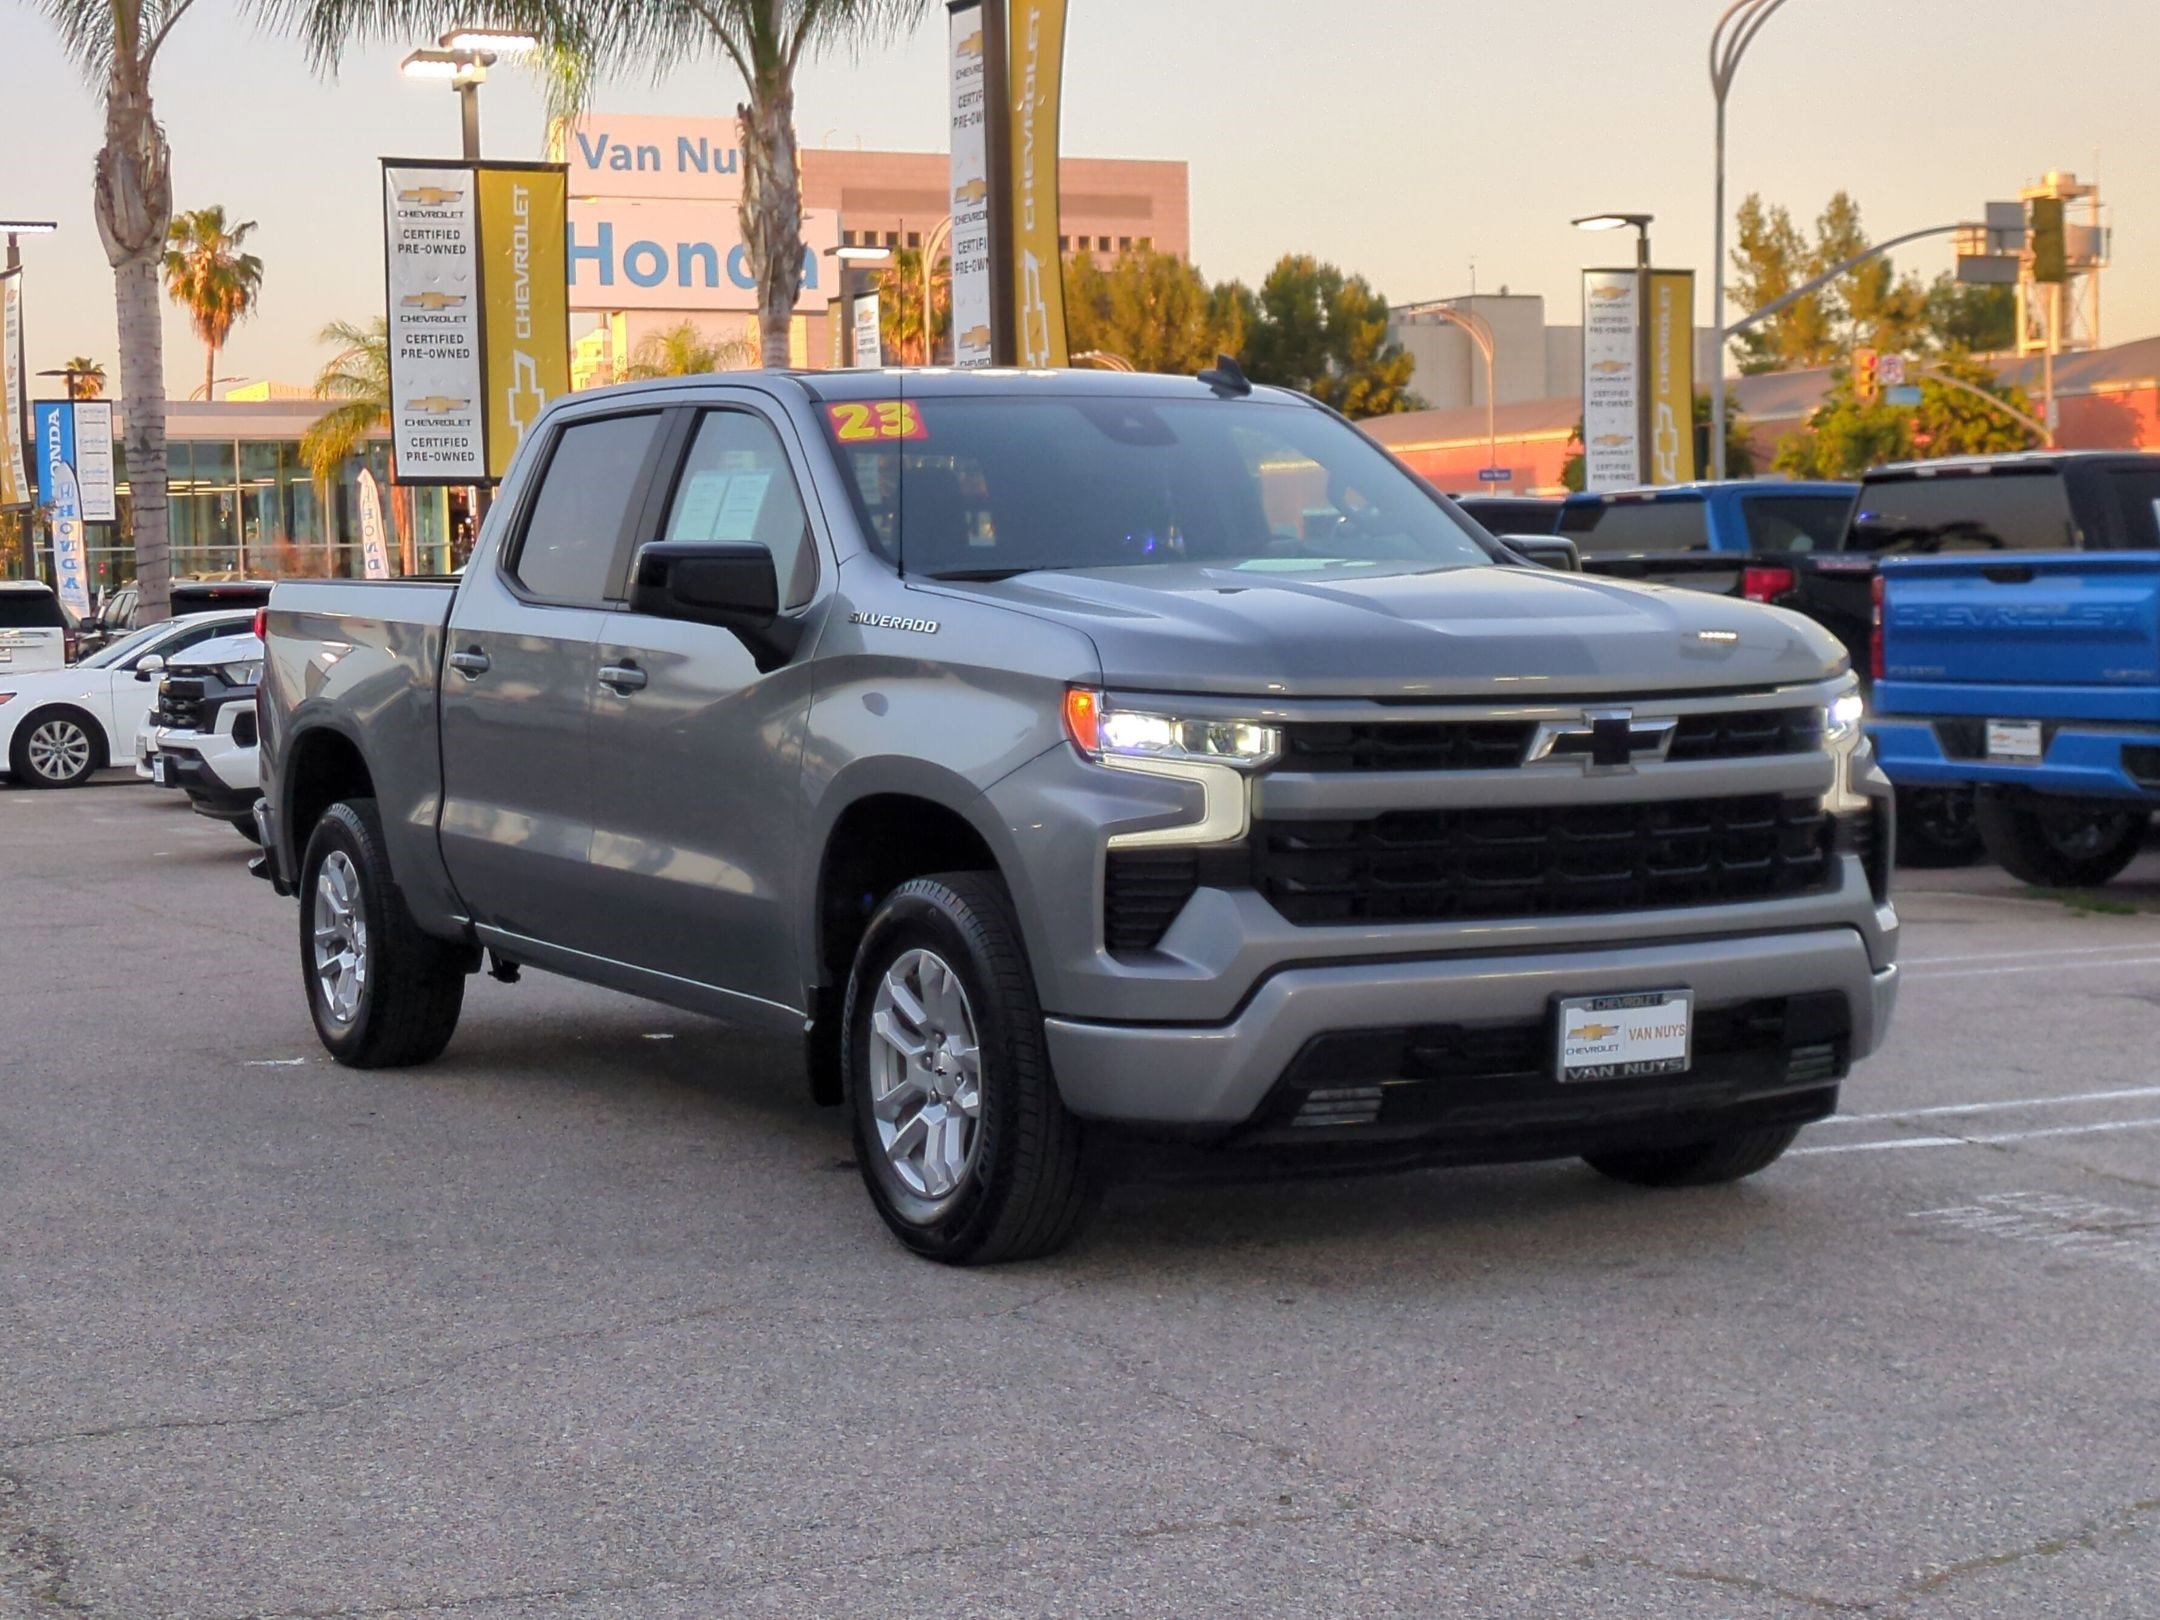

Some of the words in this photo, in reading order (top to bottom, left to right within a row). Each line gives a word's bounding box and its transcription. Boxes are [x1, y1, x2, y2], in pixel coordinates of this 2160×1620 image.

[955, 63, 984, 80] CHEVRO
[958, 89, 984, 108] CERTIF
[953, 109, 984, 128] PRE-OW
[576, 132, 661, 171] Van
[677, 136, 743, 174] Nu
[397, 210, 465, 219] CHEVROLET
[954, 210, 988, 227] CHEVRO
[402, 229, 461, 240] CERTIFIED
[397, 244, 467, 255] PRE-OWNED
[958, 236, 987, 255] CERTIFI
[513, 184, 531, 339] CHEVROLET
[400, 315, 467, 323] CHEVROLET
[405, 333, 465, 344] CERTIFIED
[400, 348, 470, 359] PRE-OWNED
[404, 419, 472, 427] CHEVROLET
[831, 401, 918, 439] 23
[410, 437, 469, 448] CERTIFIED
[405, 451, 475, 462] PRE-OWNED
[848, 611, 941, 634] SILVERADO
[1628, 1027, 1652, 1041] VAN
[1655, 1023, 1687, 1038] NUYS
[1565, 1043, 1620, 1057] CHEVROLET
[1567, 1066, 1615, 1080] VAN
[1624, 1060, 1684, 1076] NUYS
